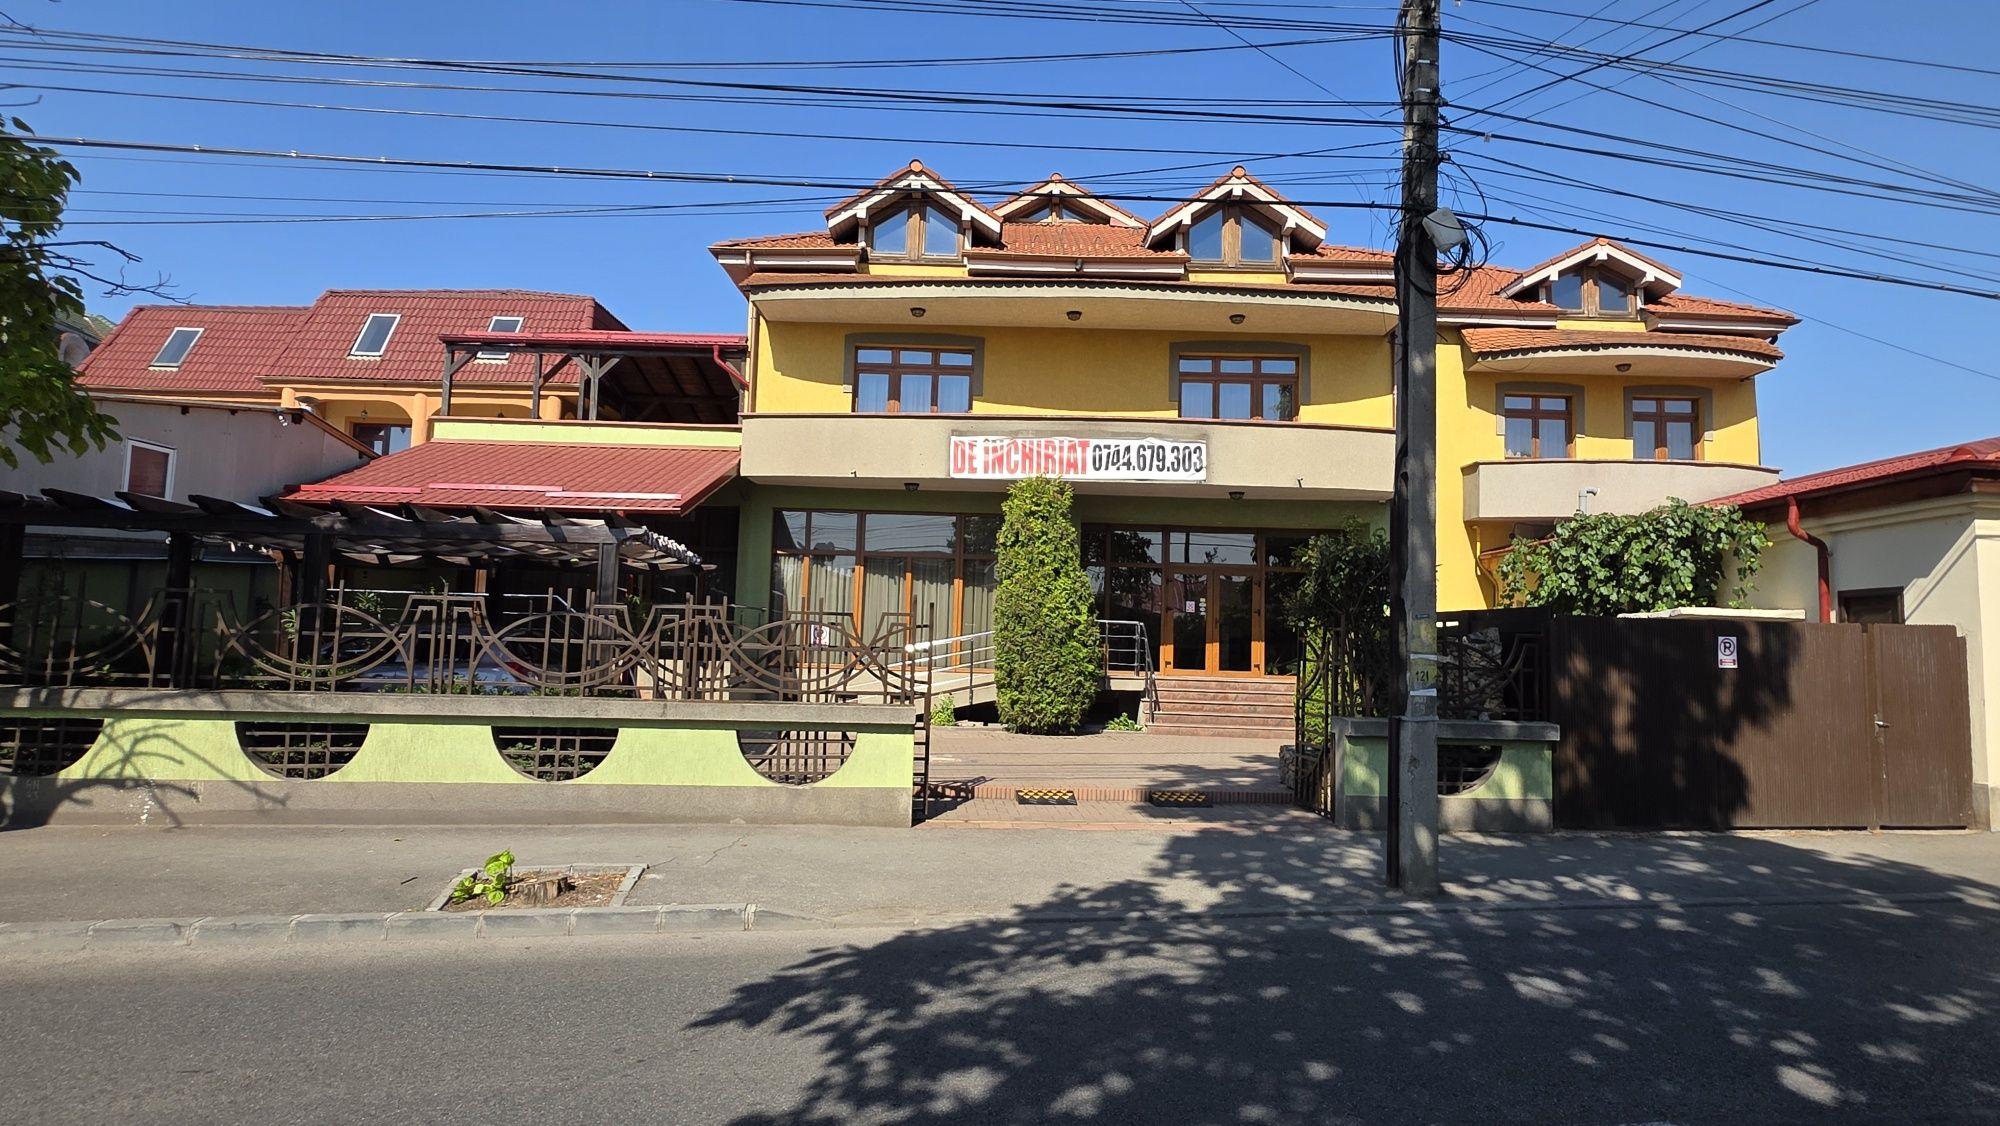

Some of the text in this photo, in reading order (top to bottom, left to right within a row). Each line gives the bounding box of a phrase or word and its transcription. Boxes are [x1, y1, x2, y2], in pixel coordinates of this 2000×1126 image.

[953, 438, 1204, 474] DE ÎNCHIRIAT 0744.679.303
